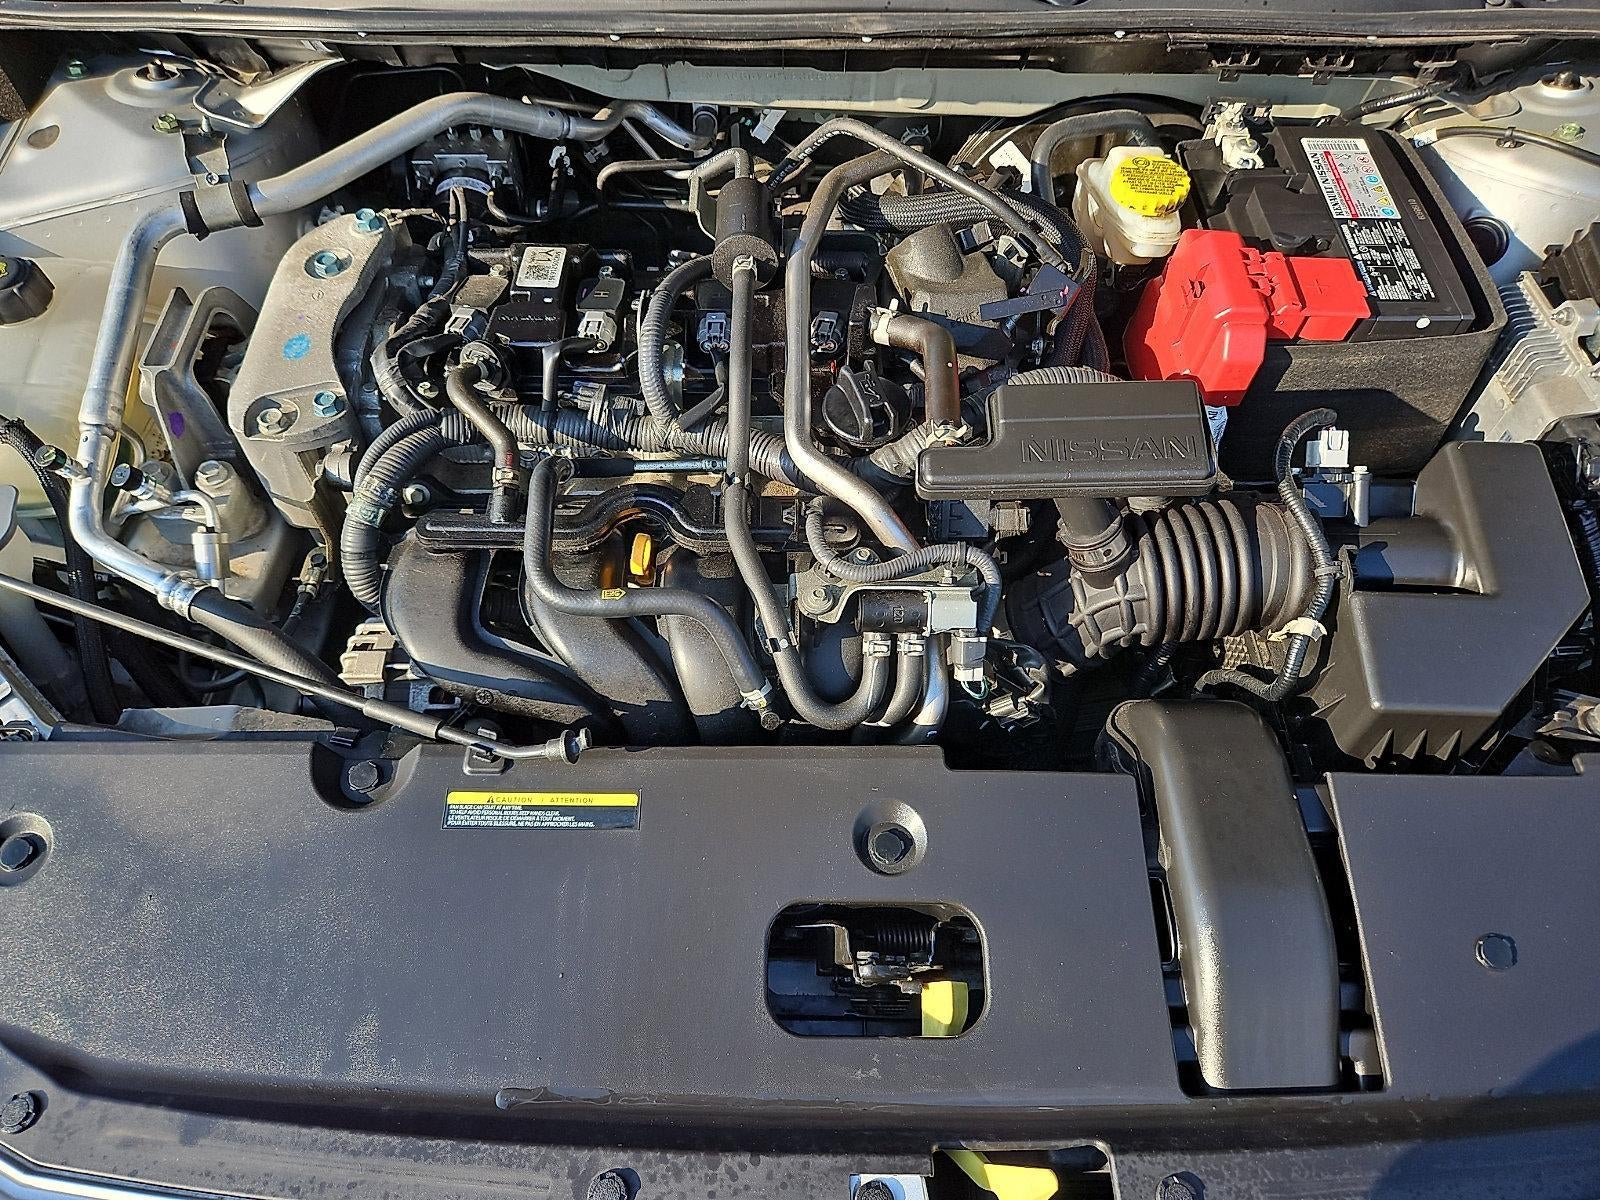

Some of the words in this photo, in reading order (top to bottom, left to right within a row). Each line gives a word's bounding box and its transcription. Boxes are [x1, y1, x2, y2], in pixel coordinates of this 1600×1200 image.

[1309, 152, 1331, 185] NISSAN
[1324, 186, 1344, 217] RENAULT
[536, 248, 555, 262] Y1
[1021, 435, 1197, 462] NISSAN
